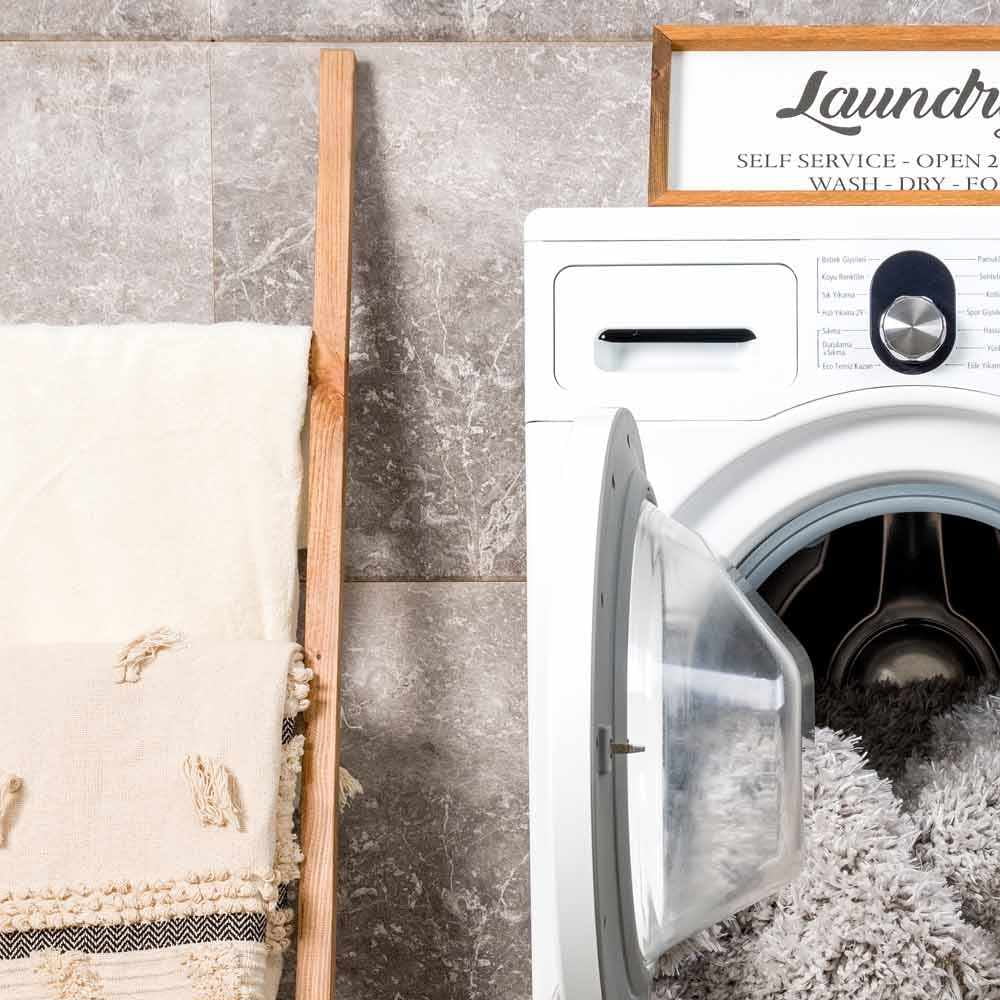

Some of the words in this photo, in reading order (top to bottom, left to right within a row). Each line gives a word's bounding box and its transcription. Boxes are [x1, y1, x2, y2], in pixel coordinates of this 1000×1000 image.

[736, 153, 792, 169] SELF
[797, 153, 897, 169] SERVICE
[916, 153, 981, 169] OPEN
[809, 176, 878, 191] WASH
[899, 176, 945, 191] DRY
